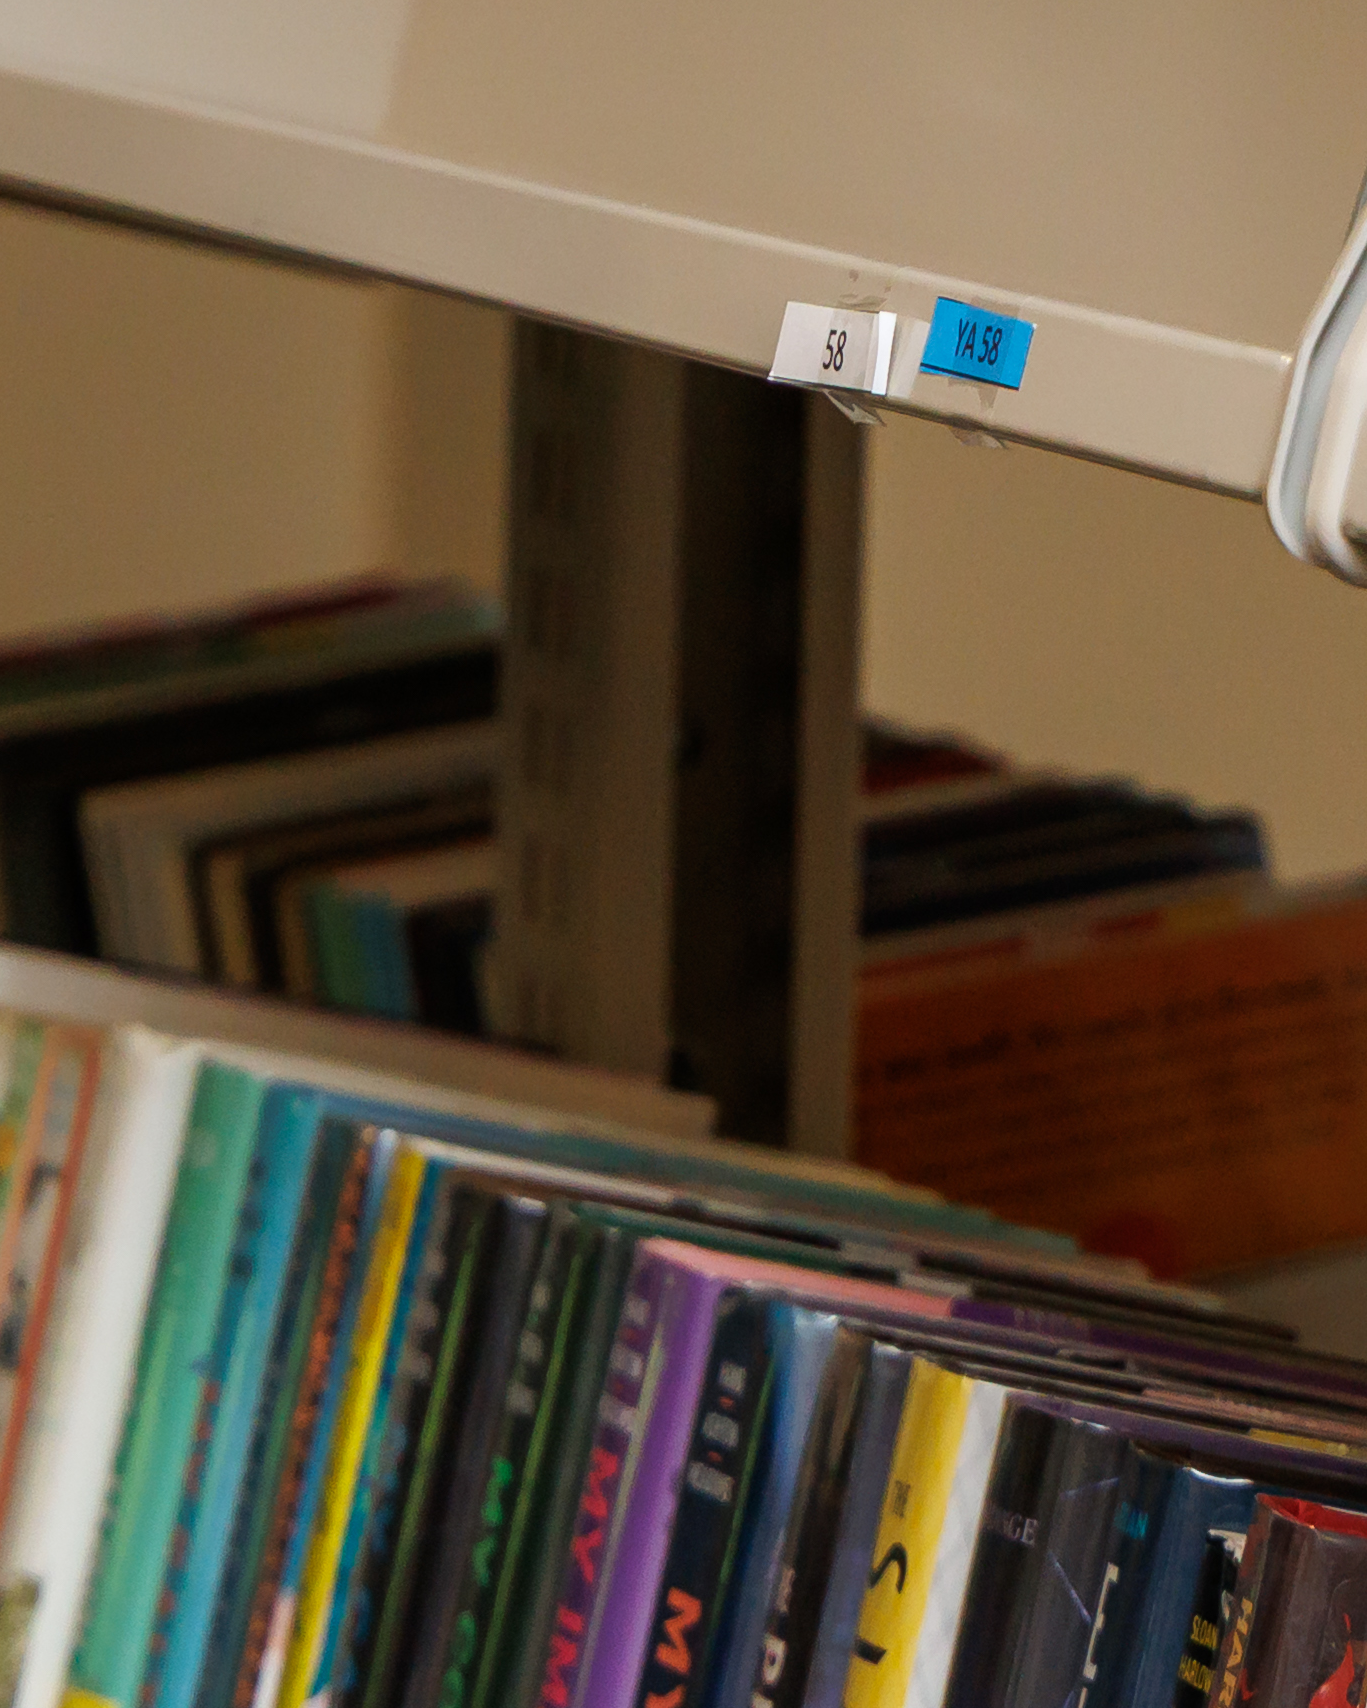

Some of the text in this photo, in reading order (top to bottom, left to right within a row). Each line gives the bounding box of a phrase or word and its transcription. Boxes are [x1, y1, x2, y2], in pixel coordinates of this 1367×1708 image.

[822, 329, 847, 372] 58
[955, 318, 1002, 365] YA 58
